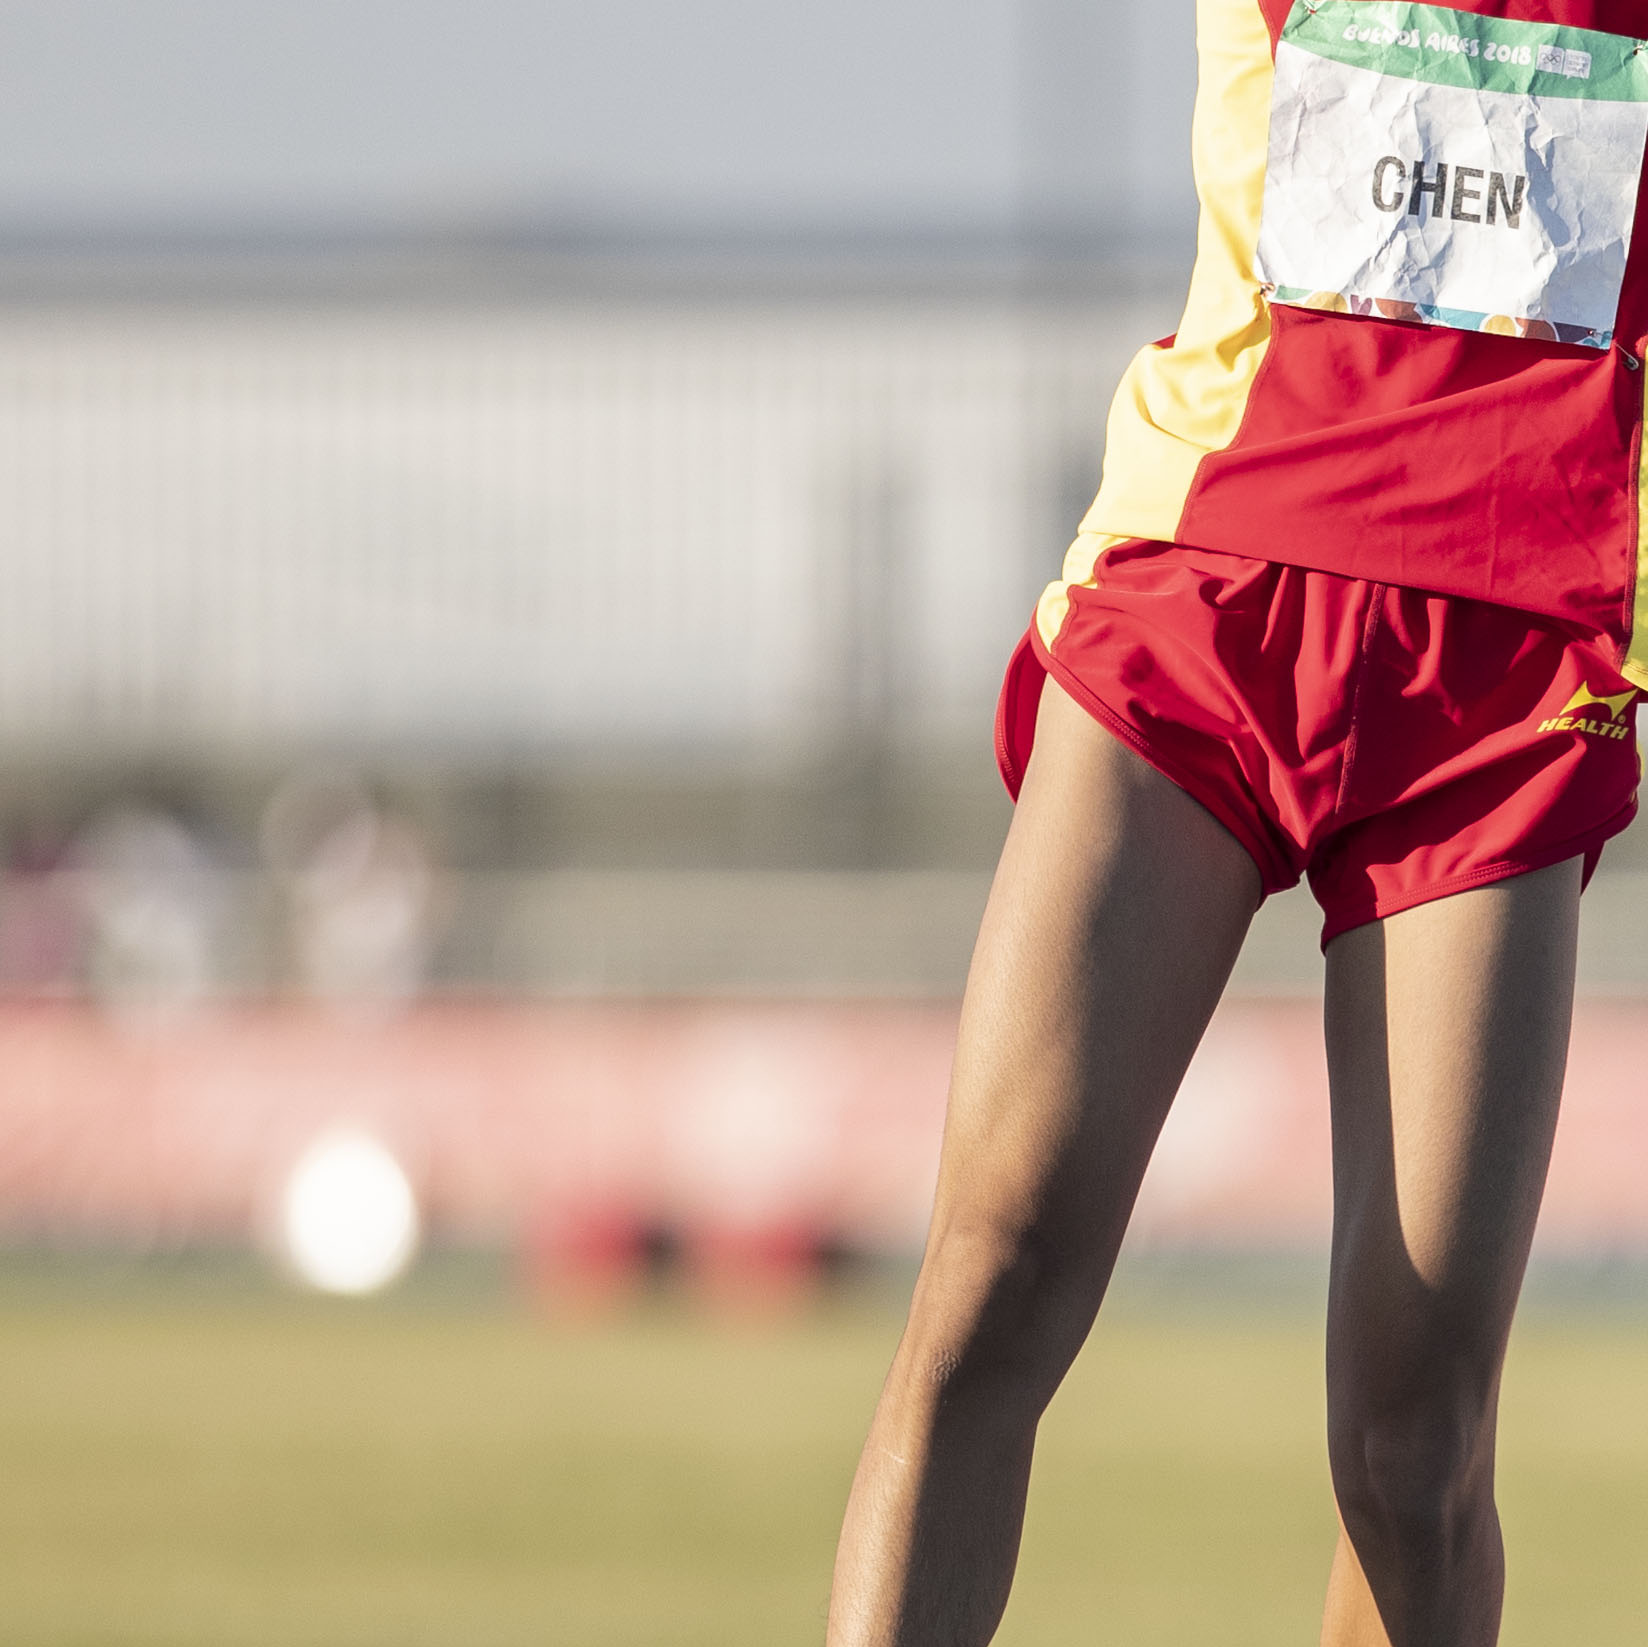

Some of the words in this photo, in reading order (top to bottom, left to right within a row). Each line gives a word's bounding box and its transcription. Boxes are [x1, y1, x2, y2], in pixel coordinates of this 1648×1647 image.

[1342, 23, 1420, 49] BUENOS
[1424, 31, 1480, 58] AIRES
[1483, 41, 1532, 66] 2018
[1372, 155, 1526, 230] CHEN
[1536, 716, 1629, 740] HEALTH
